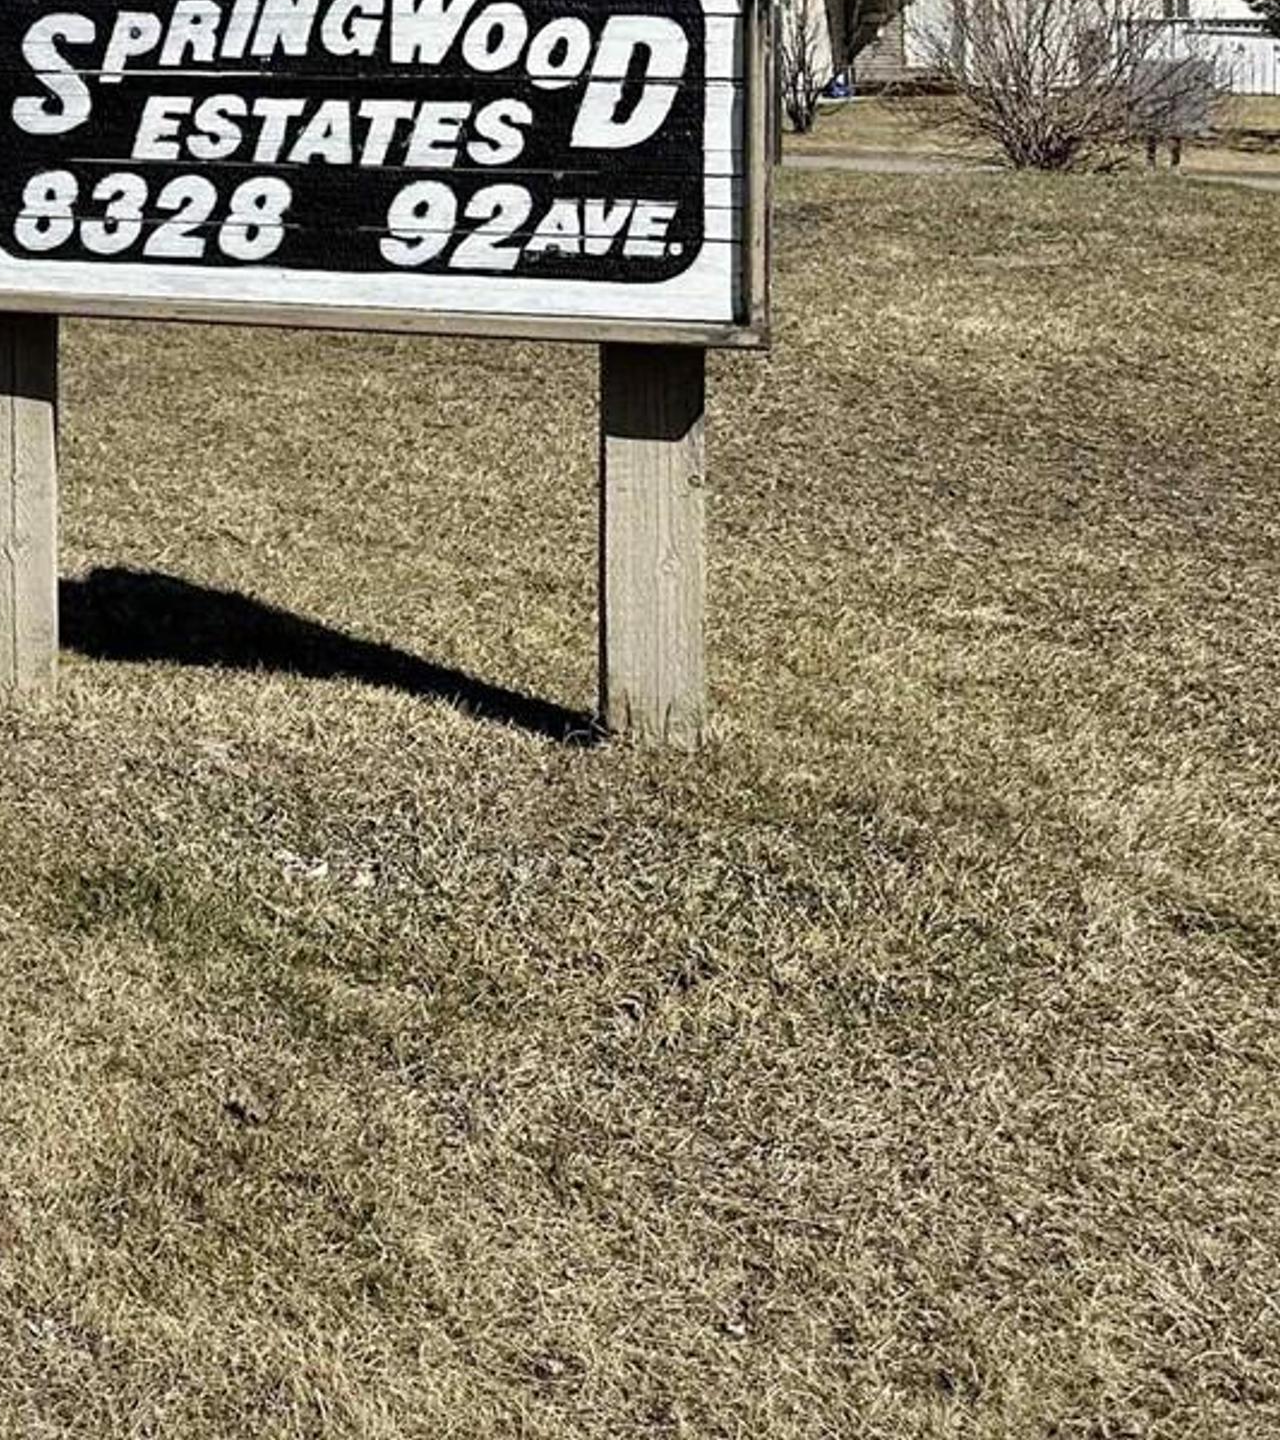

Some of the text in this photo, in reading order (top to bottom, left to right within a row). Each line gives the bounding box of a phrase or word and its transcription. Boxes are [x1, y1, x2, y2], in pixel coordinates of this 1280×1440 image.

[131, 95, 533, 169] ESTATES
[13, 170, 293, 261] 8328
[380, 180, 534, 271] 92
